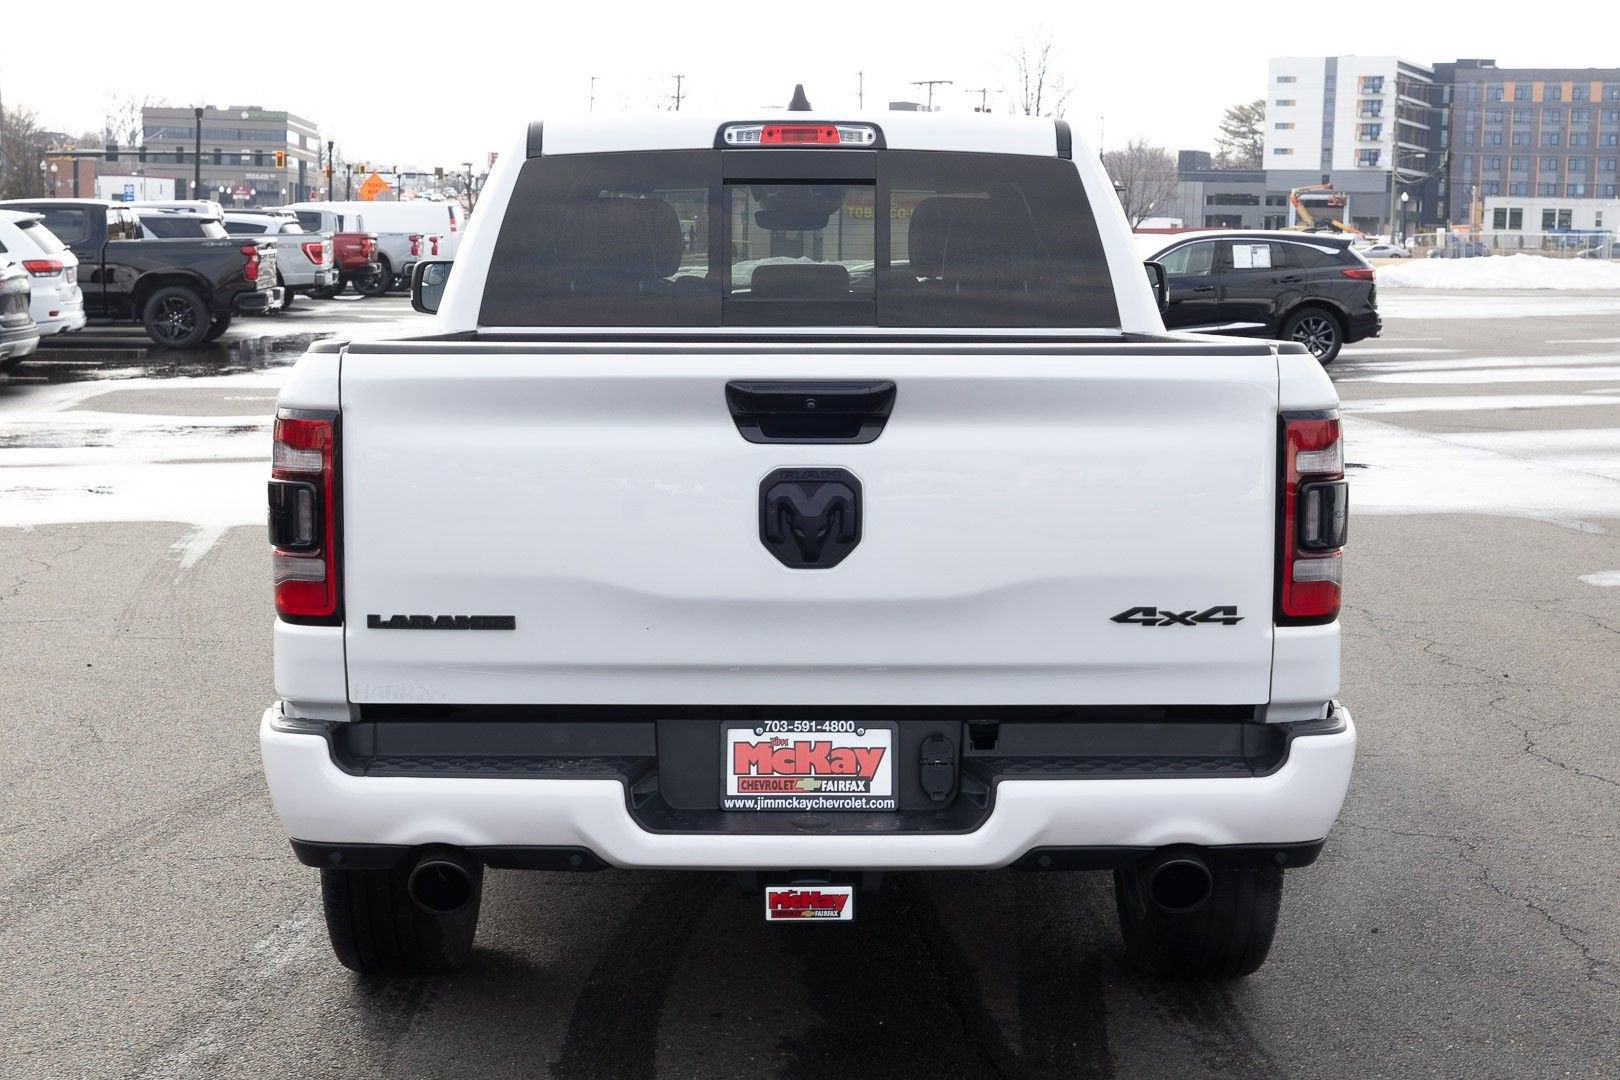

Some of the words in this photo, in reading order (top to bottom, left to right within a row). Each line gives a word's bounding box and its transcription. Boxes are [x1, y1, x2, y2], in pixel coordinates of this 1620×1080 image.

[367, 614, 516, 630] LARAMIE
[1109, 605, 1245, 626] 4x4
[764, 720, 855, 733] 703-591-4800
[733, 741, 887, 782] McKay
[741, 779, 795, 791] CHEVROLET
[821, 779, 866, 792] FAIRFAX
[724, 797, 895, 811] www.jimmckaychevrolet.com
[768, 890, 849, 912] McKay
